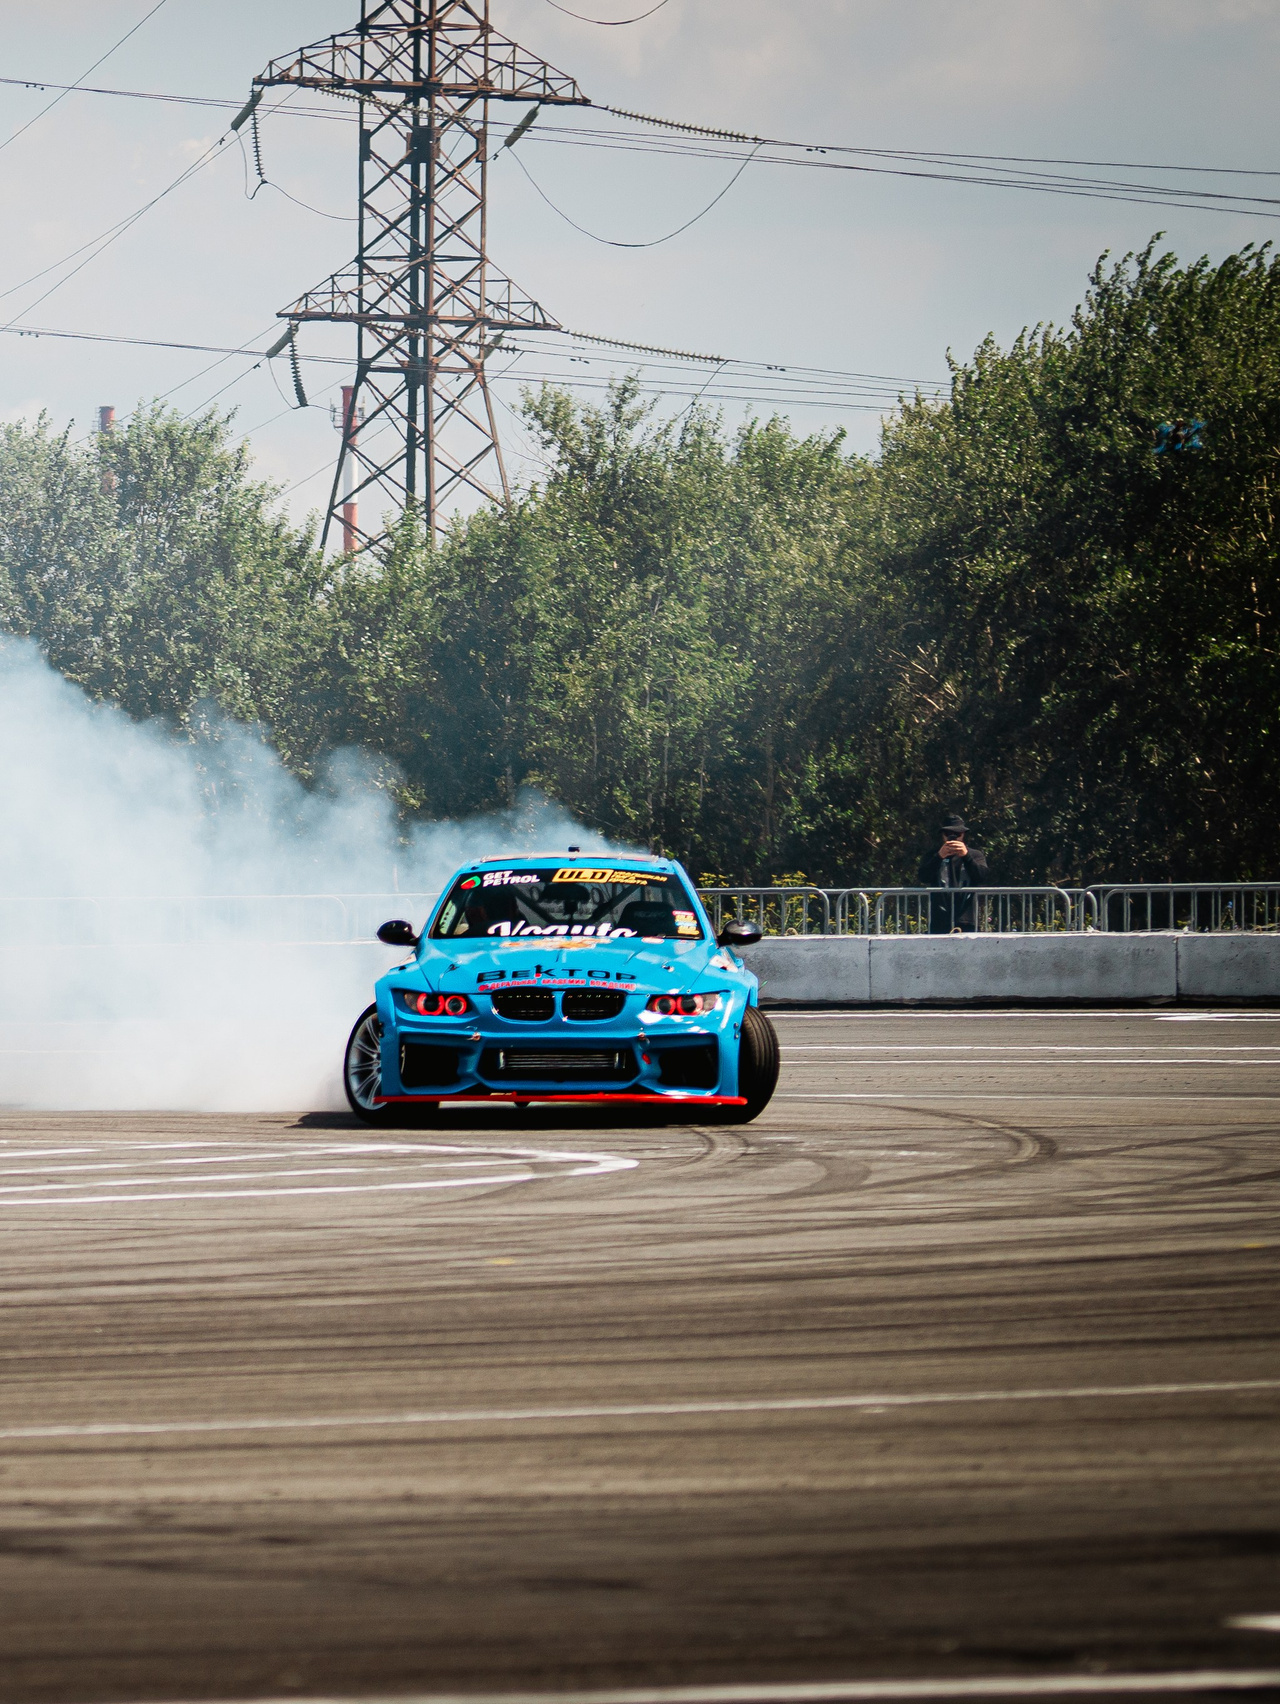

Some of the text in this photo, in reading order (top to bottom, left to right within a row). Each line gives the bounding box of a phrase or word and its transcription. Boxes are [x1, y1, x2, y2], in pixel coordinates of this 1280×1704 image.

[483, 870, 513, 880] GET
[558, 871, 607, 880] ULD
[482, 875, 541, 888] PETROL
